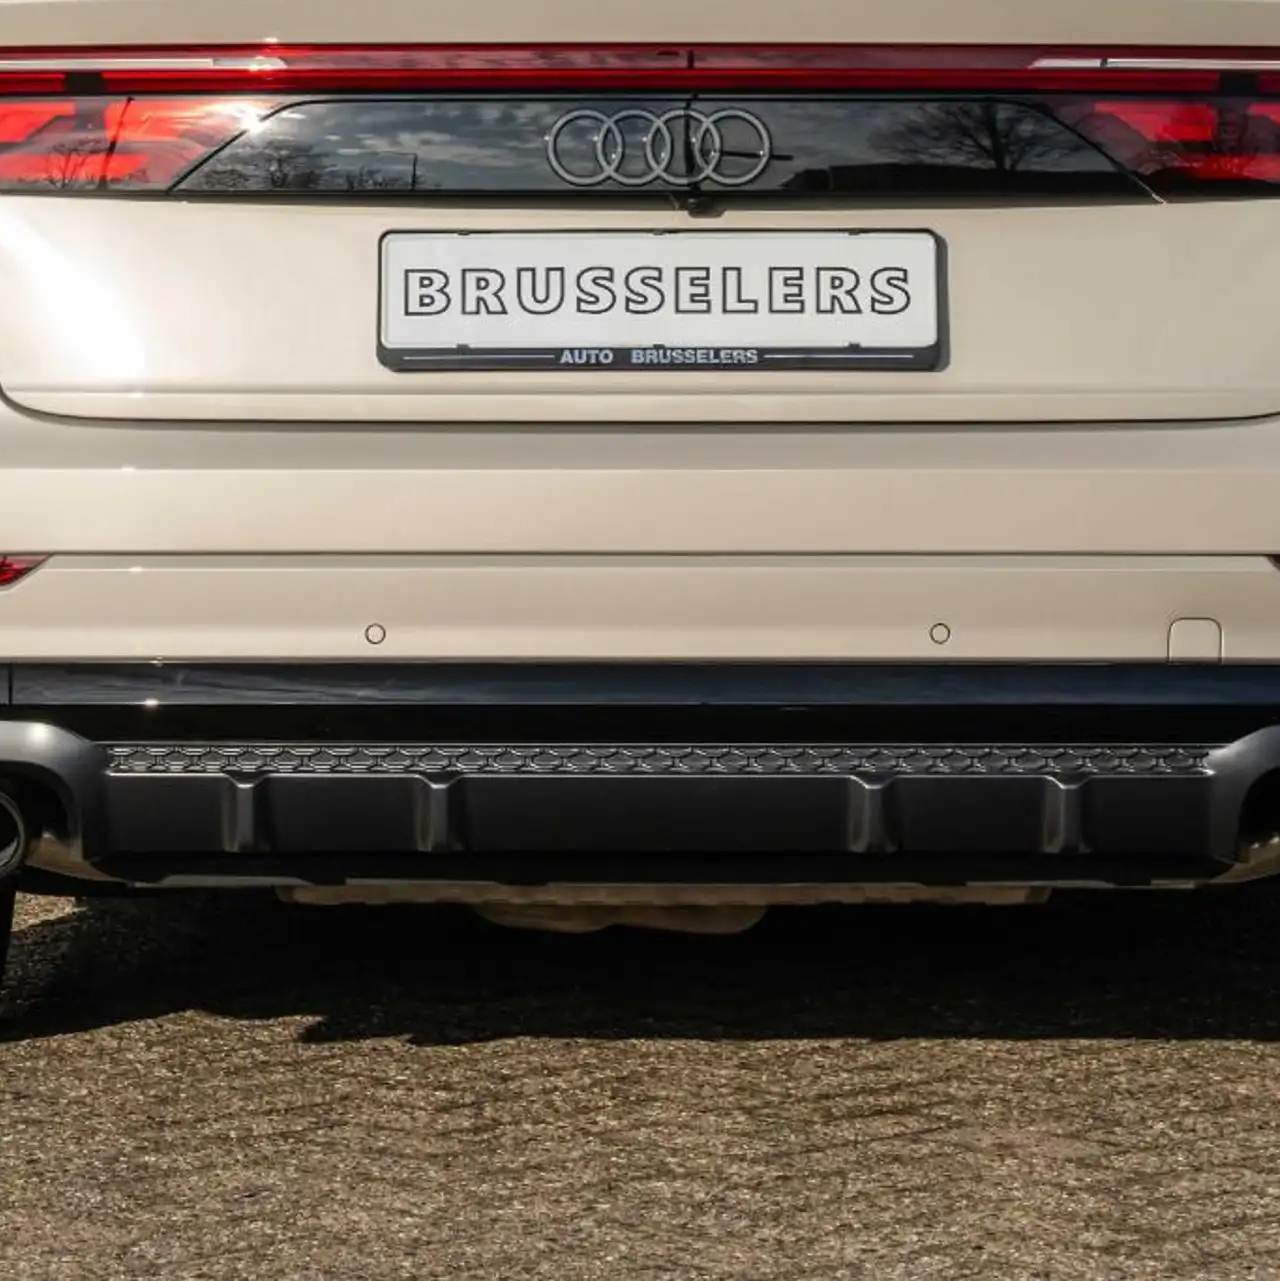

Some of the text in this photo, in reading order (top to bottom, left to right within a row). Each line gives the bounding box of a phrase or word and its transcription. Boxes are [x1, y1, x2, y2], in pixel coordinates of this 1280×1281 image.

[404, 266, 911, 316] BRUSSELERS
[560, 349, 758, 364] AUTO BRUSSELERS
